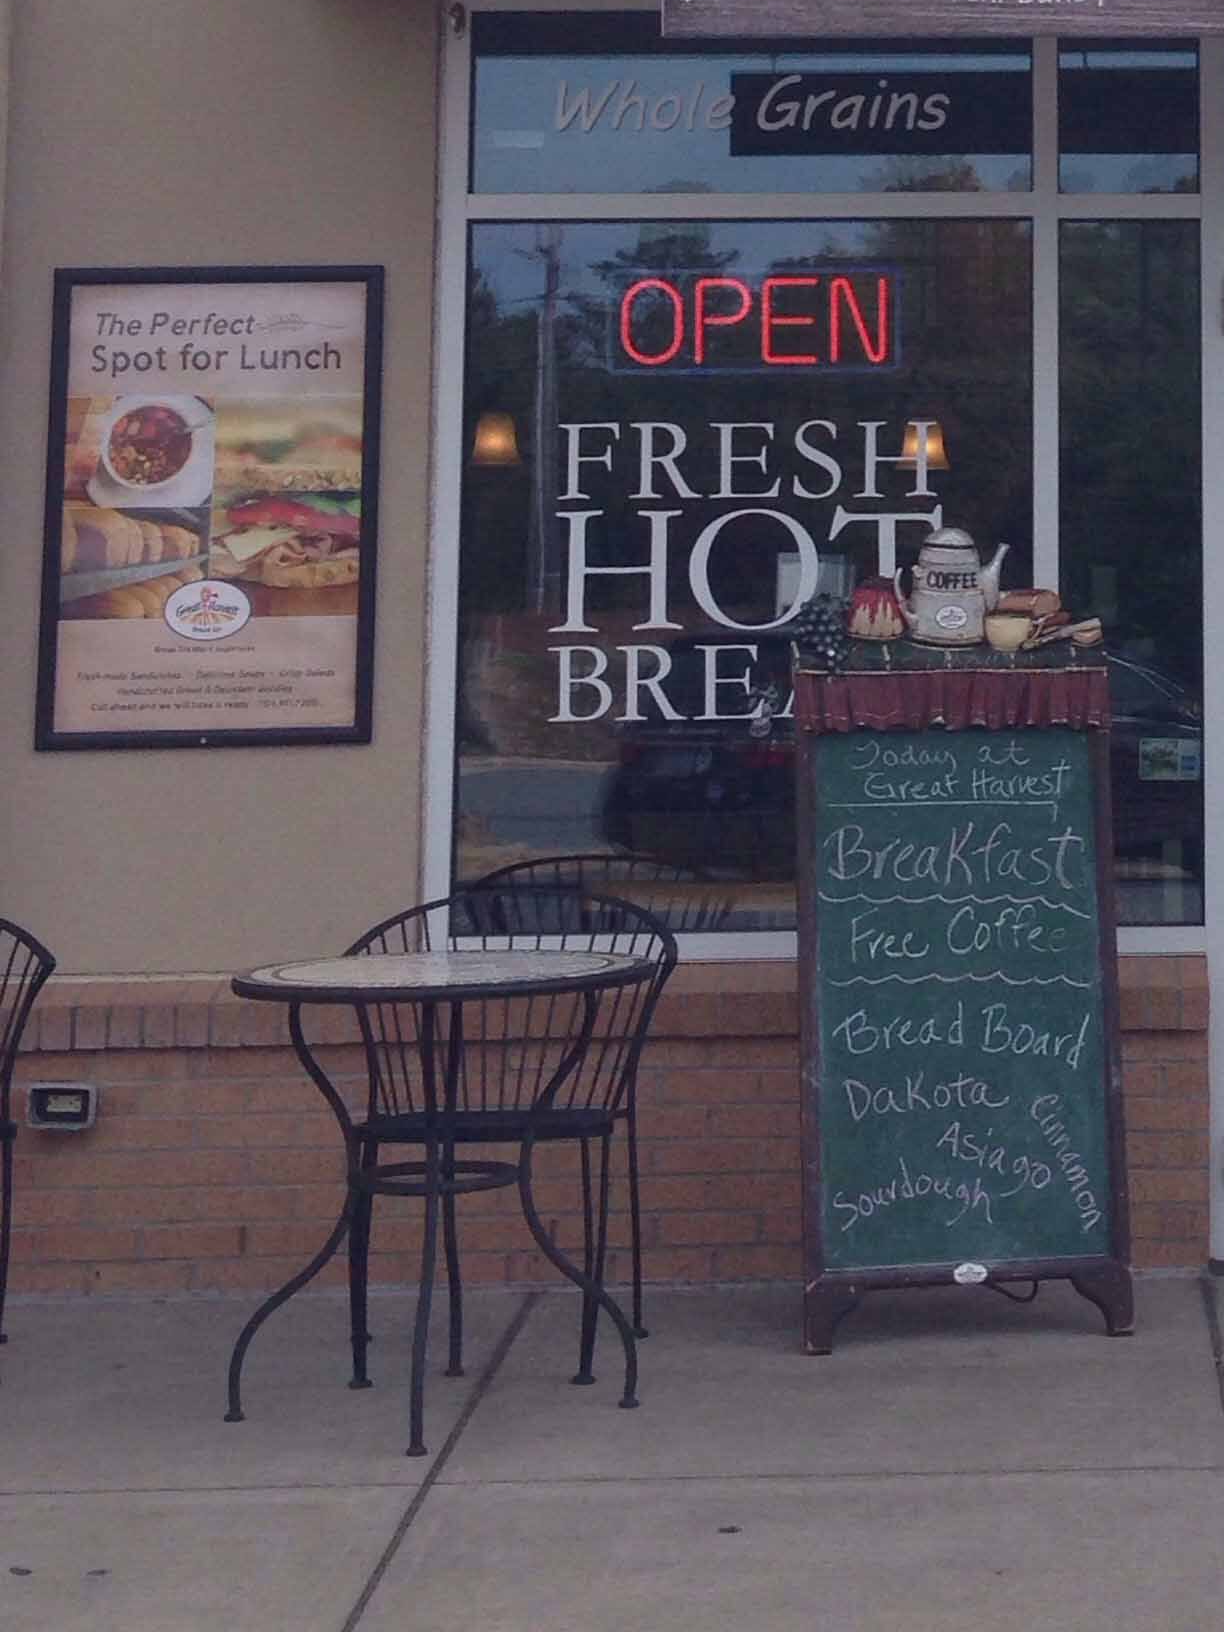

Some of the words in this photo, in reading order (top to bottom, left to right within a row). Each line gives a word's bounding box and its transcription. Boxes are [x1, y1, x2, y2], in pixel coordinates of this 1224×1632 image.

[554, 79, 734, 135] Whole
[756, 73, 951, 134] Grains
[96, 311, 142, 337] The
[149, 311, 256, 337] Perfect
[619, 276, 890, 366] OPEN
[91, 344, 168, 377] Spot
[180, 342, 229, 372] for
[240, 341, 342, 372] Lunch
[556, 418, 939, 501] FRESH
[546, 503, 944, 634] HOT
[926, 570, 979, 590] COFFEE
[546, 643, 796, 725] BRE
[850, 739, 957, 776] Today
[977, 739, 1032, 766] at
[863, 771, 960, 800] Great
[971, 759, 1072, 800] Harvest
[850, 907, 930, 963] Free
[946, 903, 1067, 955] Coffee
[831, 1000, 964, 1055] Bread
[980, 1001, 1091, 1070] Board
[936, 1121, 1052, 1197] Asiago
[1030, 1093, 1103, 1233] Cinnamon
[832, 1157, 993, 1232] Sourdough
